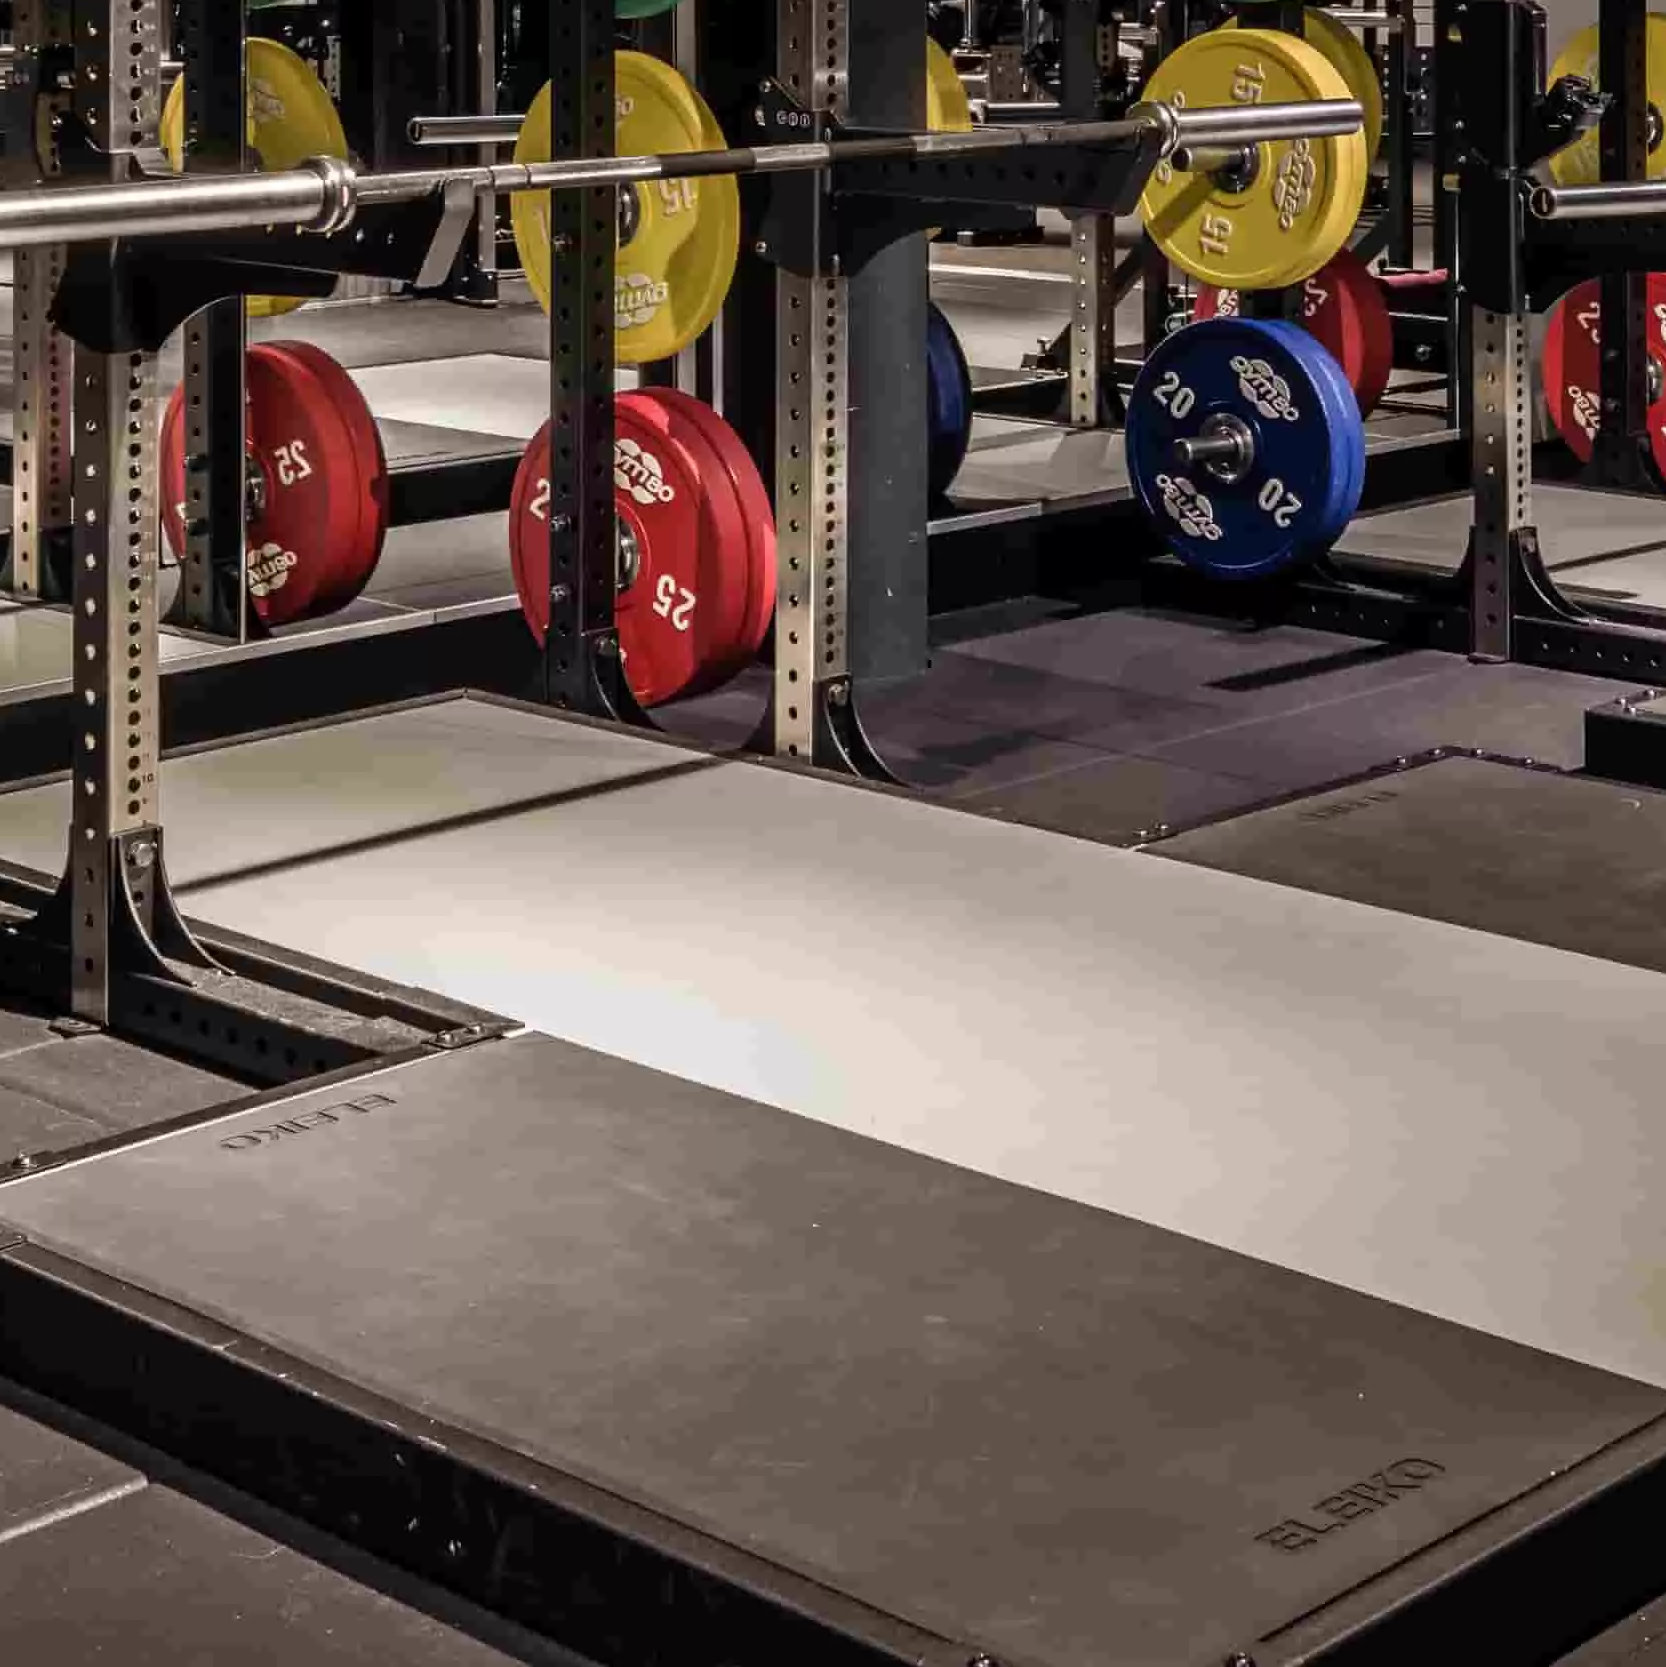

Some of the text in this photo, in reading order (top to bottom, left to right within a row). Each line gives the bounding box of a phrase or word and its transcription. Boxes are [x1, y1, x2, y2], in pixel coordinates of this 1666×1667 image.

[1234, 61, 1265, 105] 15
[1199, 213, 1232, 257] 15
[1152, 371, 1196, 420] 20
[1258, 477, 1302, 529] 20
[652, 574, 697, 632] 25
[1253, 1457, 1446, 1554] ELEIKO
